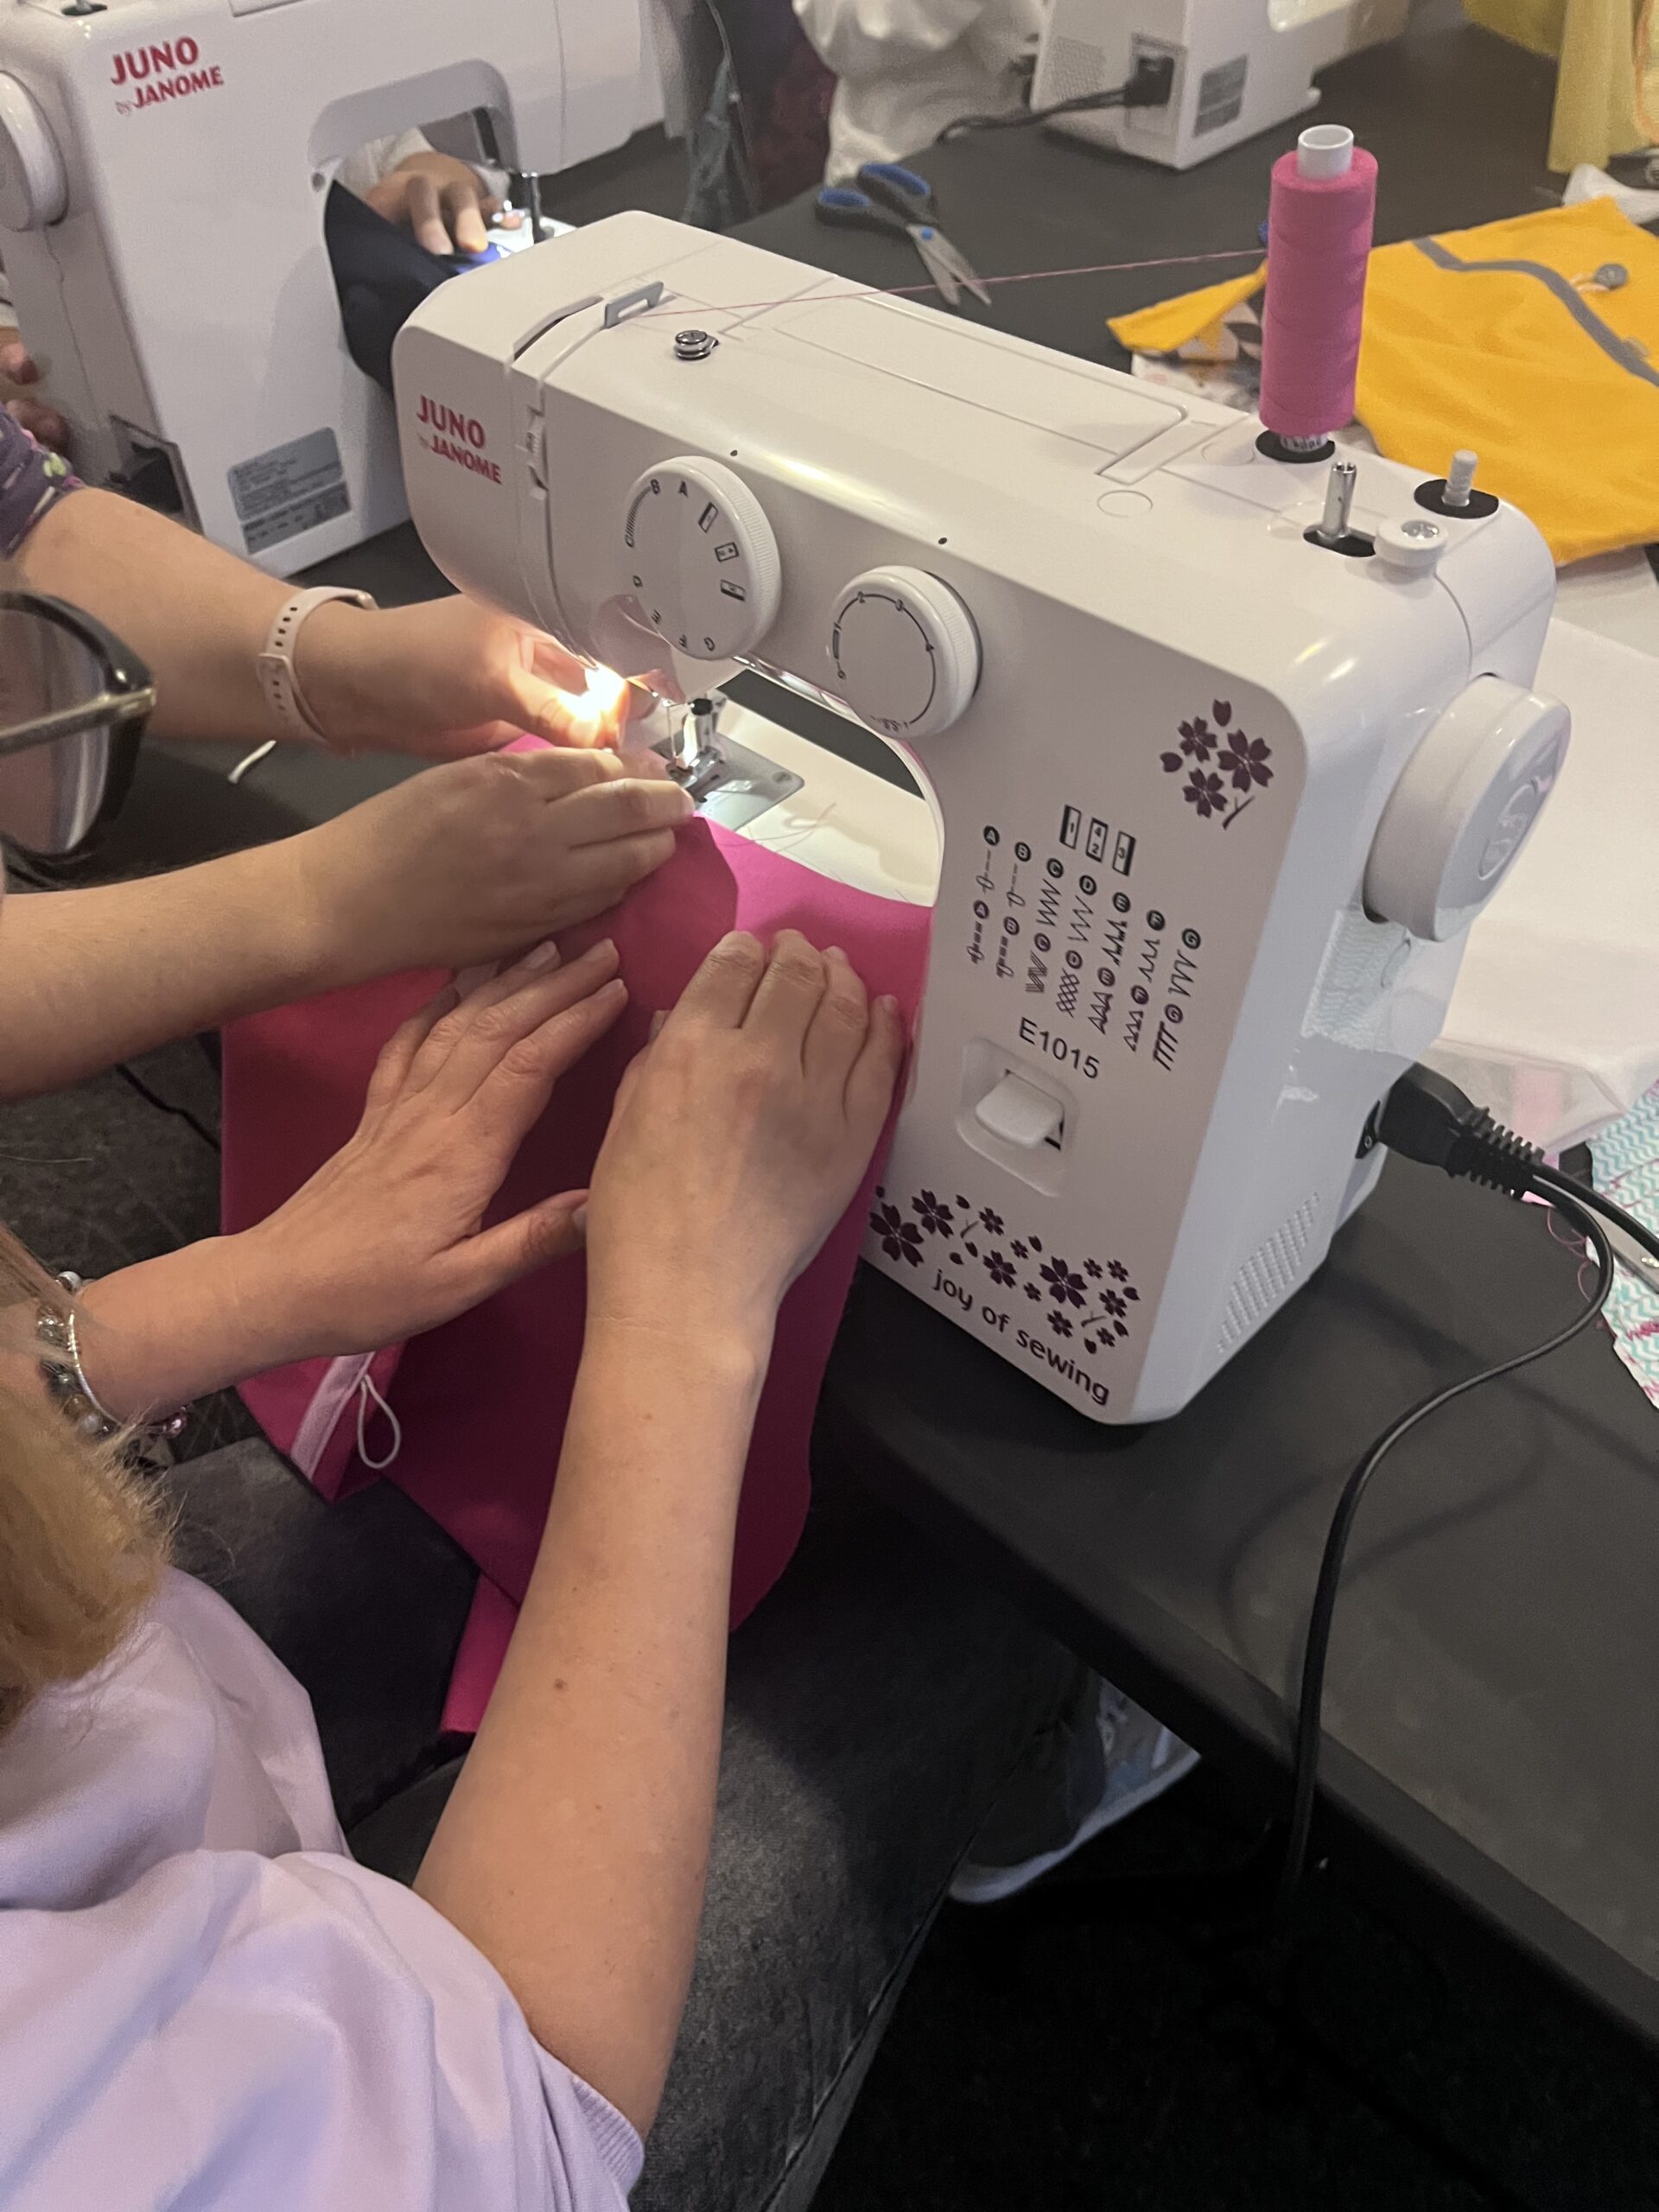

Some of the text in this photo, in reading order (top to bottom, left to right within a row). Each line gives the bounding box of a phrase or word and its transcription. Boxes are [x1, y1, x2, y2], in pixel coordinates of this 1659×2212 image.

[111, 36, 199, 85] JUNO
[133, 66, 225, 109] JANOME
[412, 394, 486, 448] JUNO
[430, 435, 503, 485] JANOME
[650, 479, 689, 498] B A
[1091, 842, 1100, 855] 2
[1094, 826, 1103, 837] 4
[1117, 846, 1126, 859] 3
[1020, 1016, 1100, 1079] E1015
[931, 1268, 1109, 1407] joy of sewing
